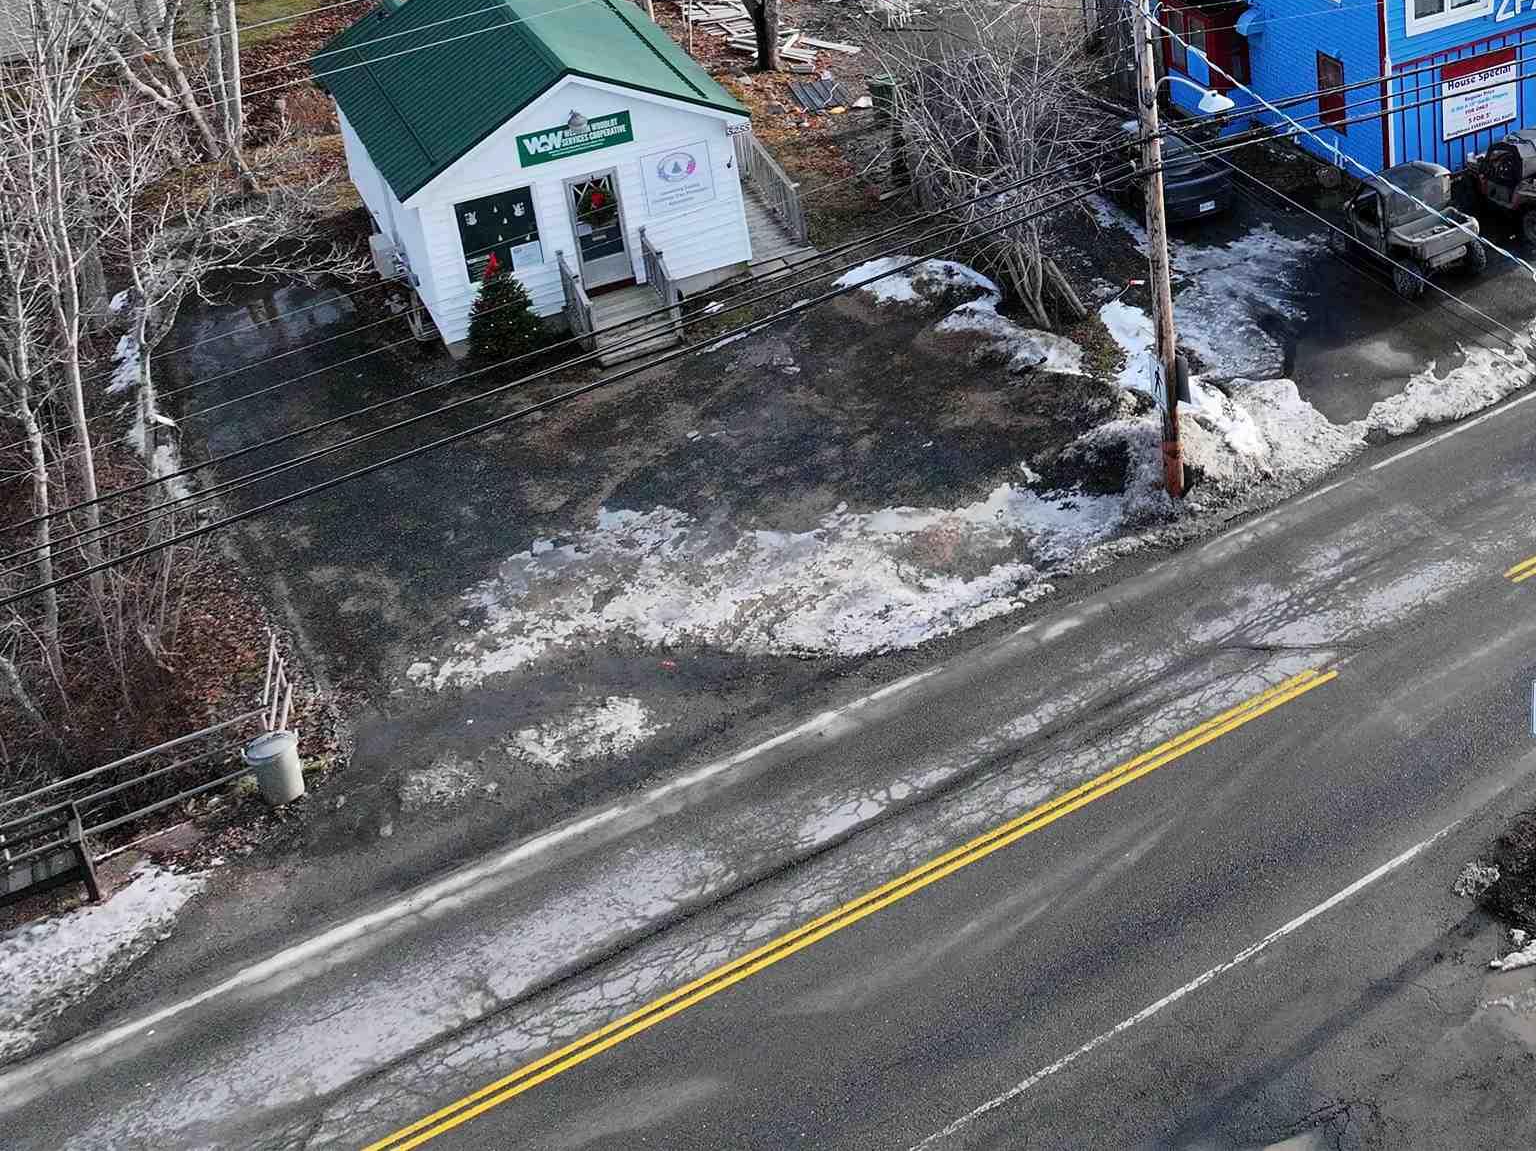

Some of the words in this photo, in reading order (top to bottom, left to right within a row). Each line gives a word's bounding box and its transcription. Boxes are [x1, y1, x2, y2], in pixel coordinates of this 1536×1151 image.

[1447, 76, 1476, 91] House
[1478, 64, 1511, 82] Special
[589, 124, 627, 141] COOPERATIVE
